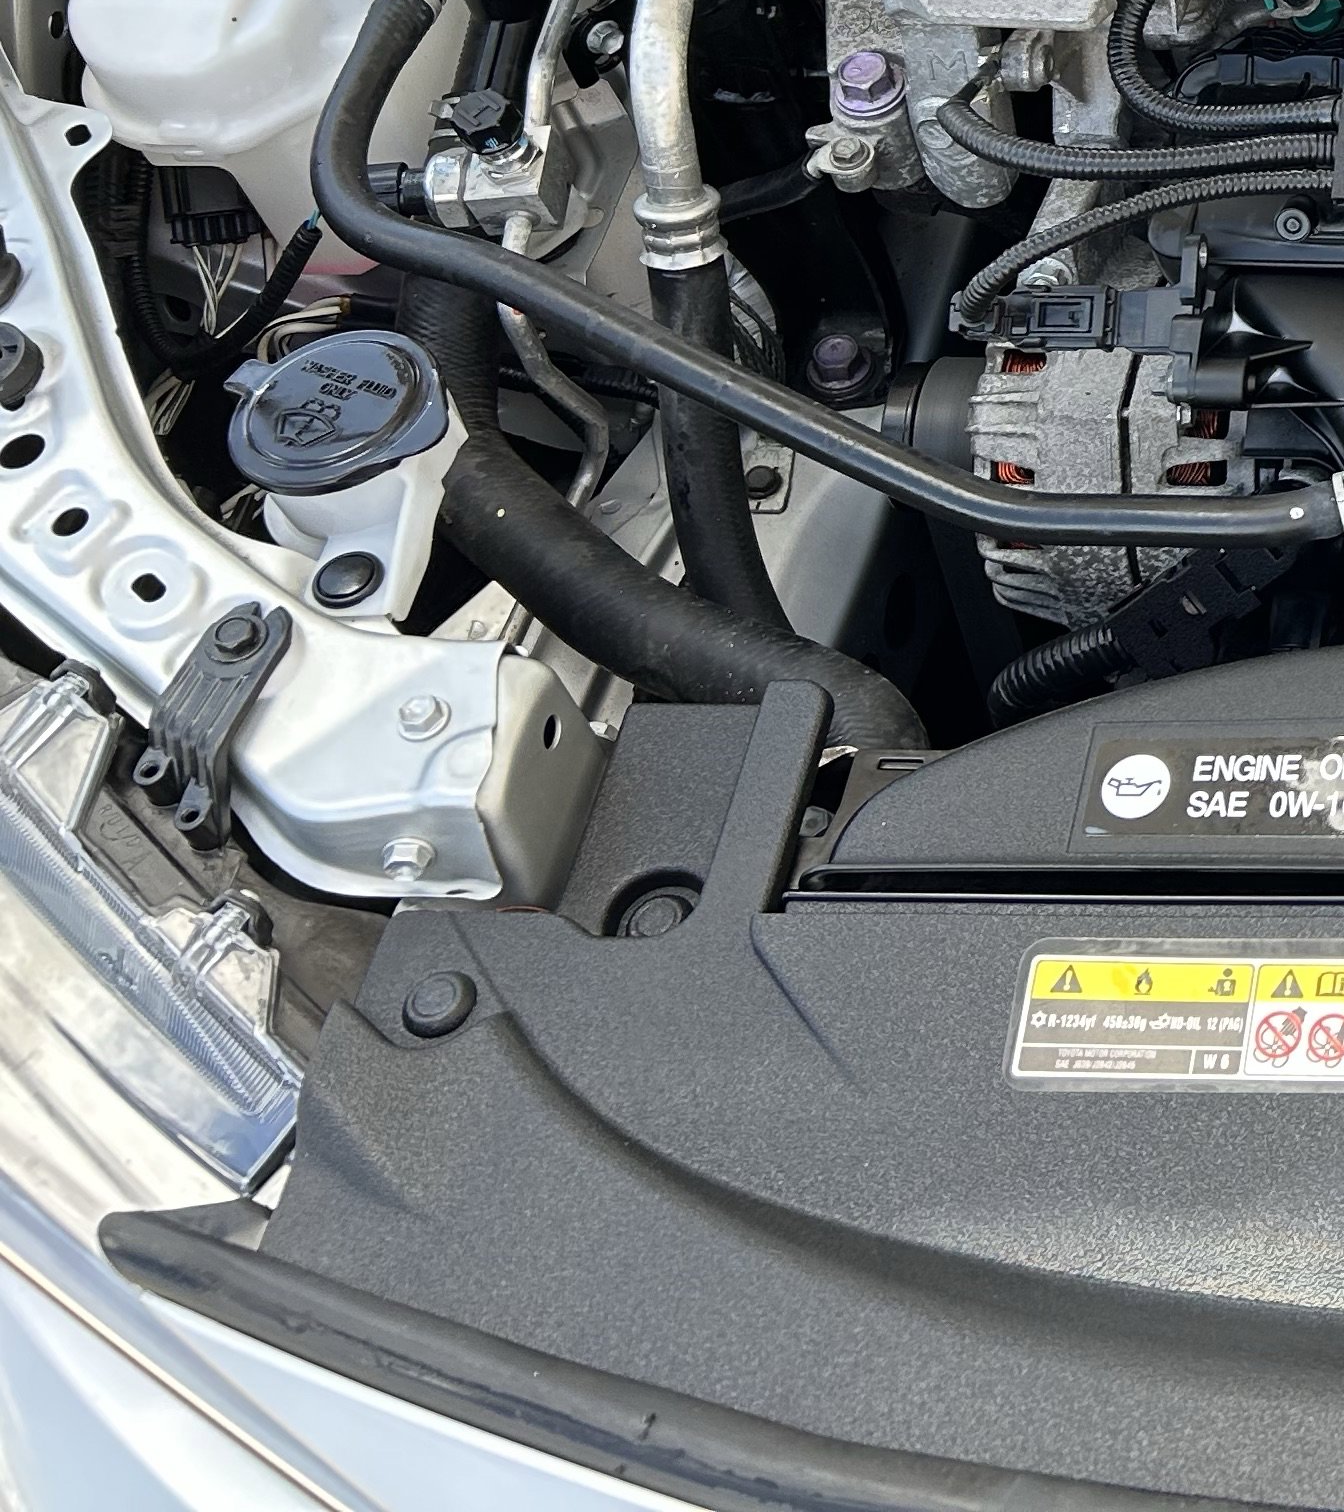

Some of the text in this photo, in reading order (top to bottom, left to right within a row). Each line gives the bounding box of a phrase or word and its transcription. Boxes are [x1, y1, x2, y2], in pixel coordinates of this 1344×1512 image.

[1193, 754, 1302, 782] ENGINE
[1186, 791, 1247, 818] SAE
[1047, 1013, 1097, 1031] R-1234yf
[1206, 1016, 1218, 1031] 12
[1219, 1016, 1244, 1033] (PAG)
[1058, 1048, 1083, 1058] TOYOTA
[1203, 1053, 1218, 1069] W
